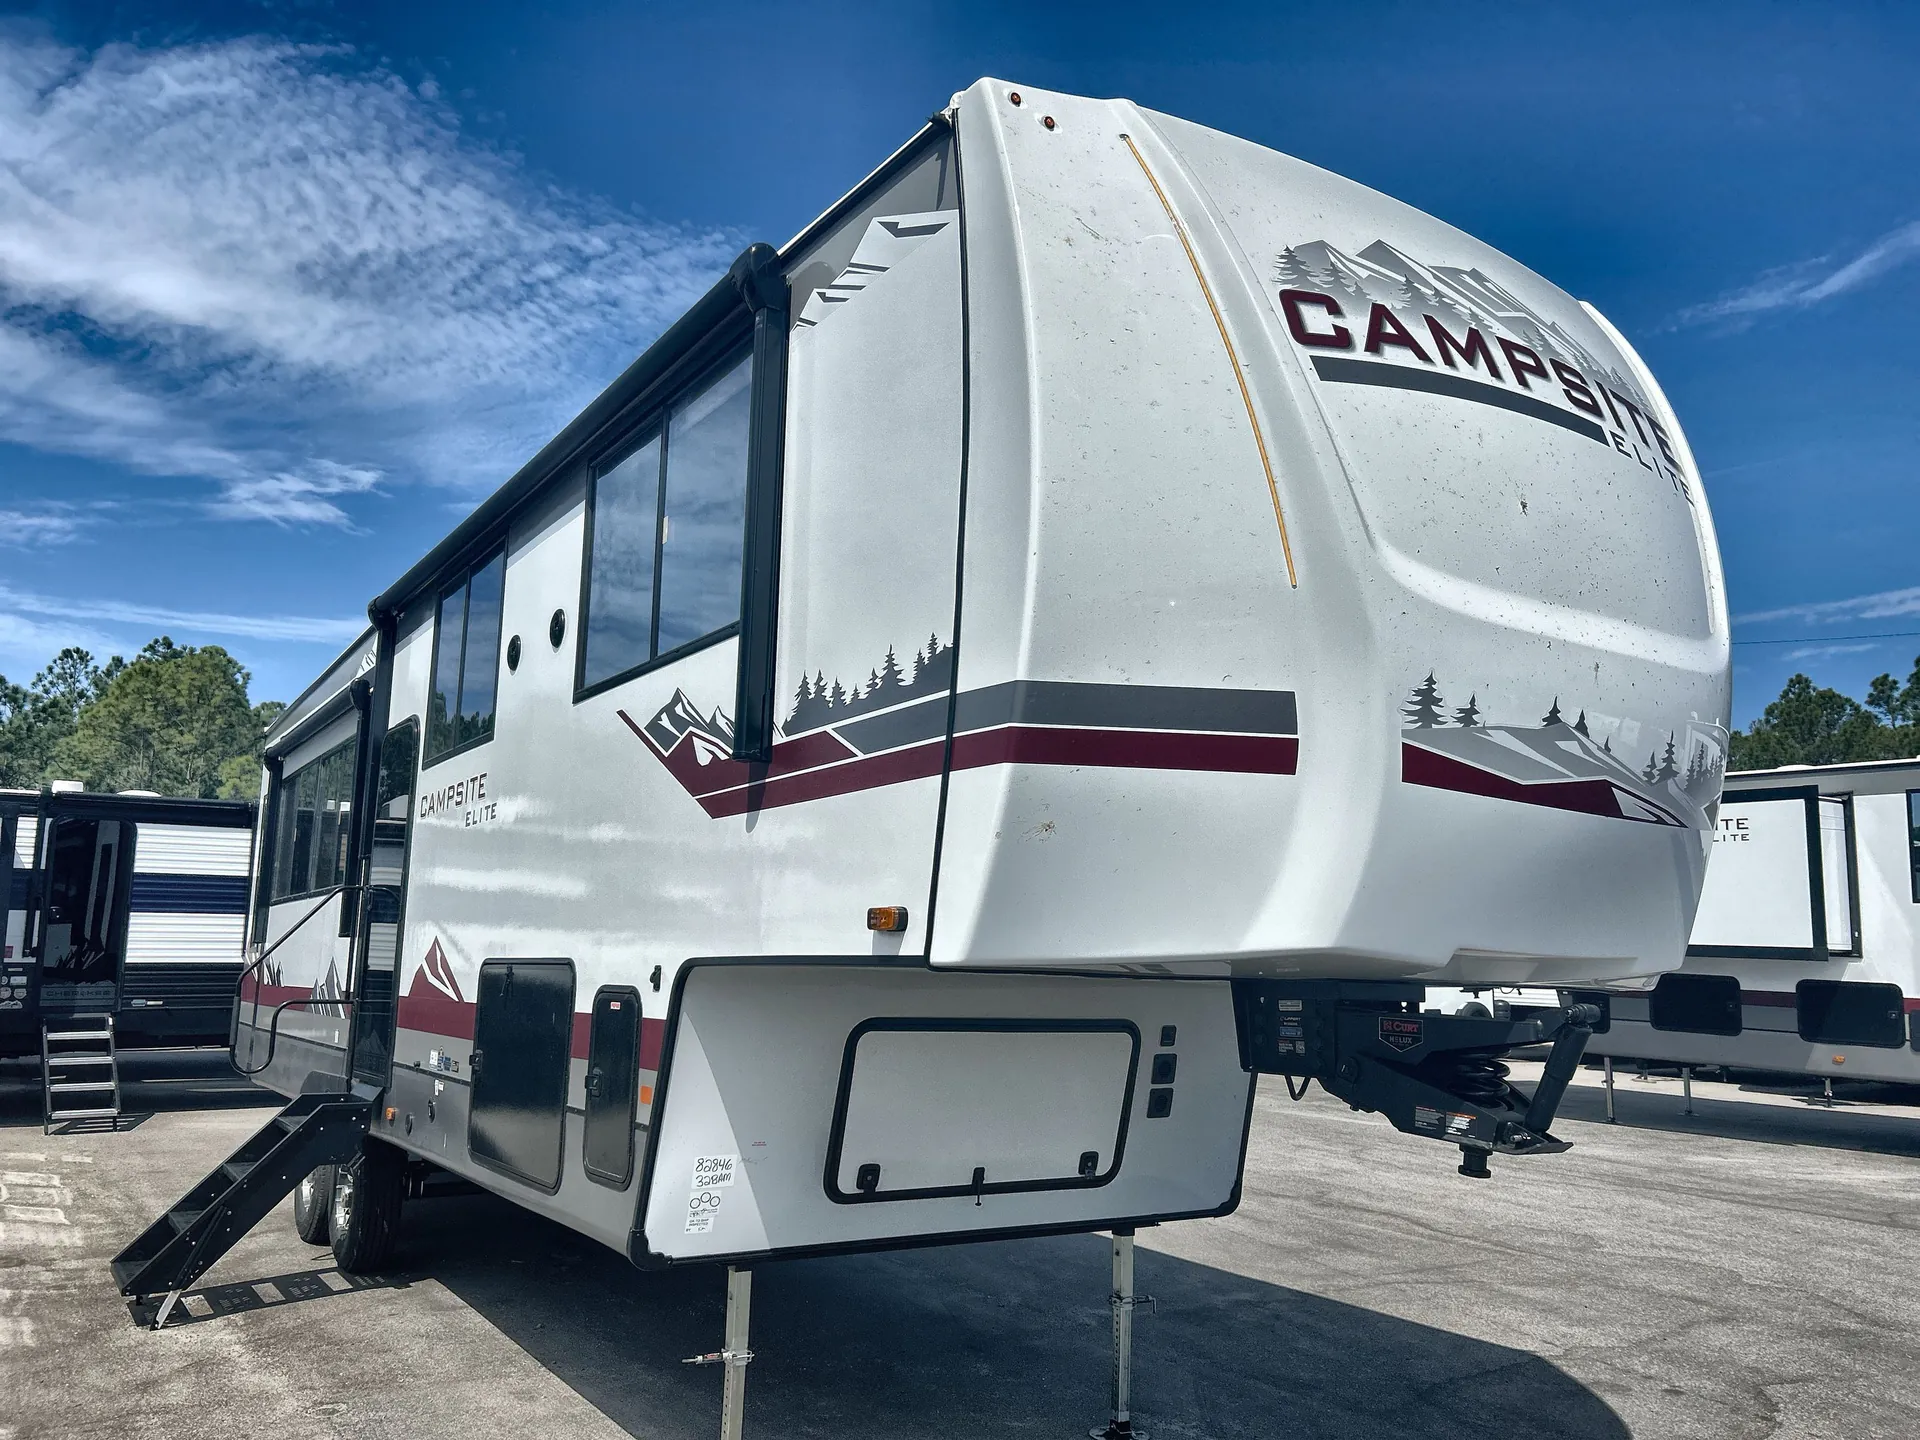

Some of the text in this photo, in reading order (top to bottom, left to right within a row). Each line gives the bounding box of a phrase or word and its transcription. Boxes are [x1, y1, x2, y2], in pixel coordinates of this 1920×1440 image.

[1279, 288, 1685, 478] CAMPSITE
[1609, 430, 1695, 507] ELITE
[420, 772, 488, 818] CAMPSITE
[465, 802, 498, 828] ELITE
[695, 1157, 733, 1173] 82846
